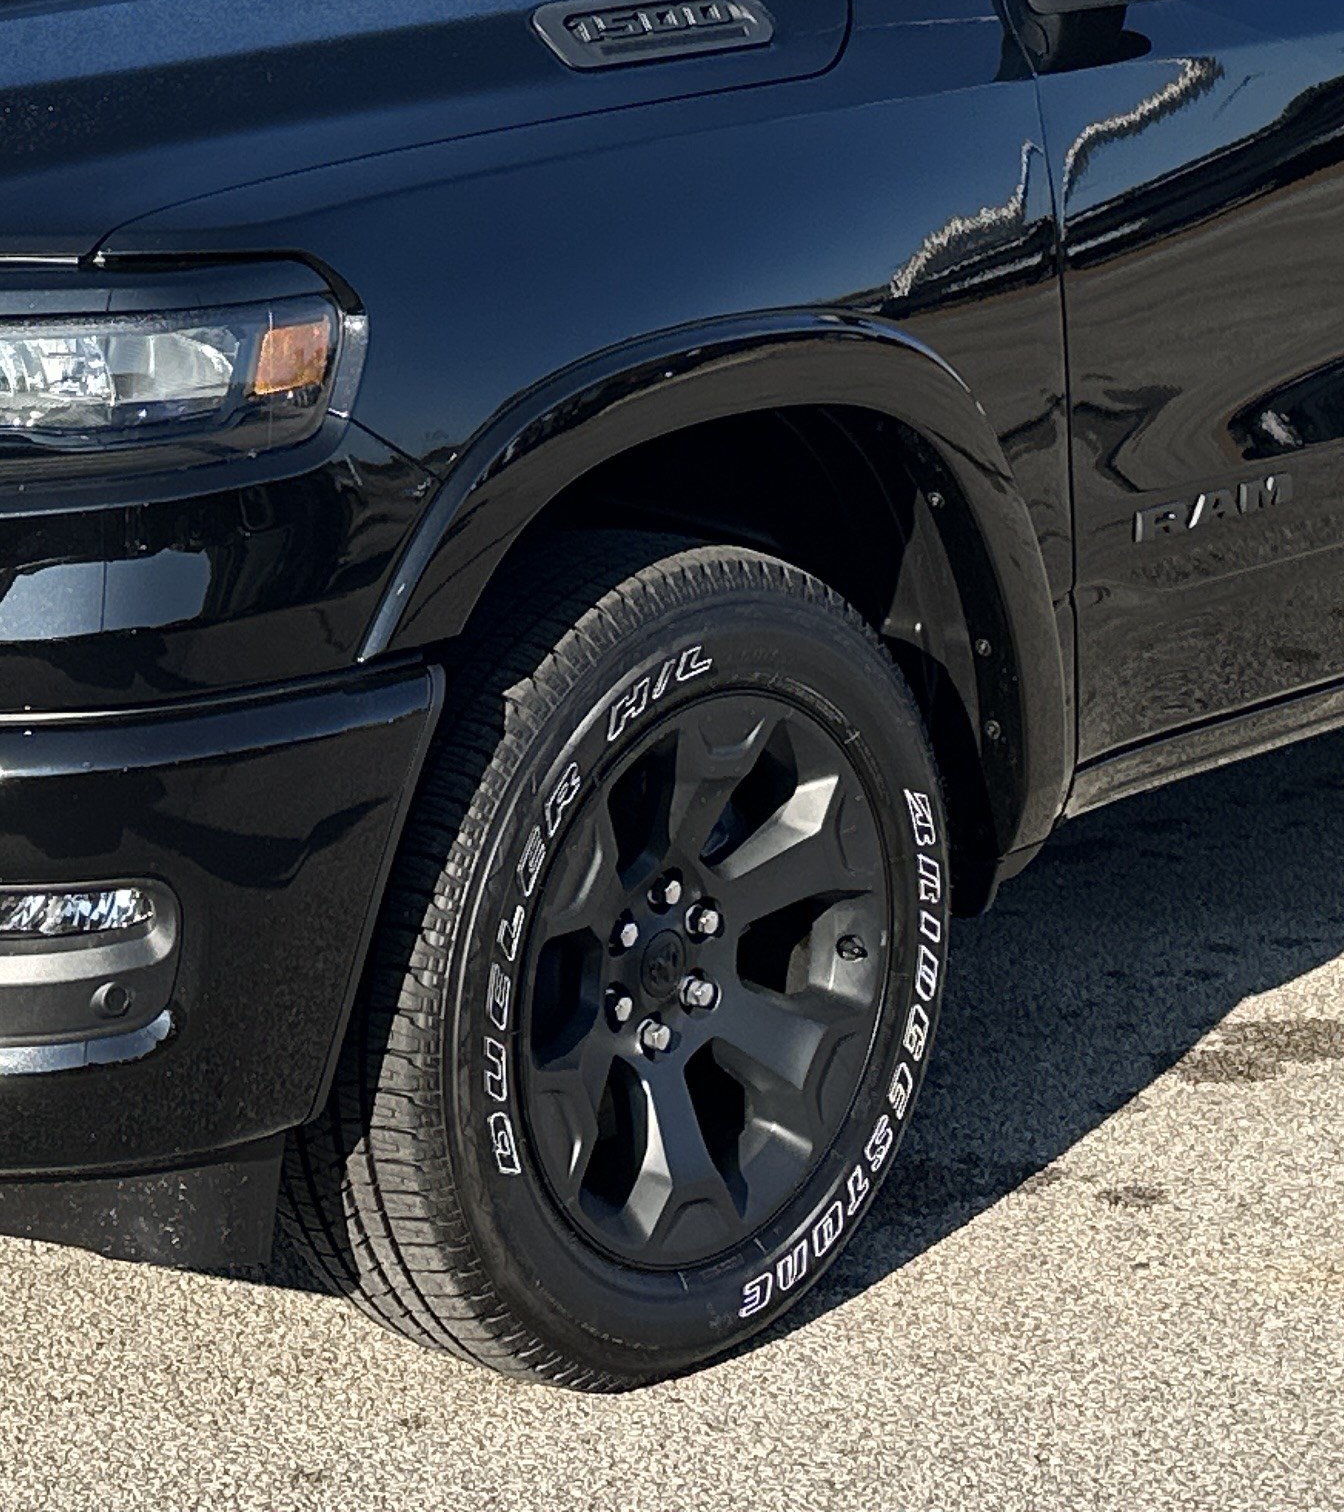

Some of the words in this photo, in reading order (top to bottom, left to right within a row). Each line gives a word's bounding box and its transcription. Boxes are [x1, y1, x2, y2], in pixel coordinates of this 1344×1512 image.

[567, 2, 730, 43] 1500
[1134, 472, 1293, 543] RAM
[483, 761, 581, 1175] DUELER
[737, 788, 943, 1318] BRIDGESTONE
